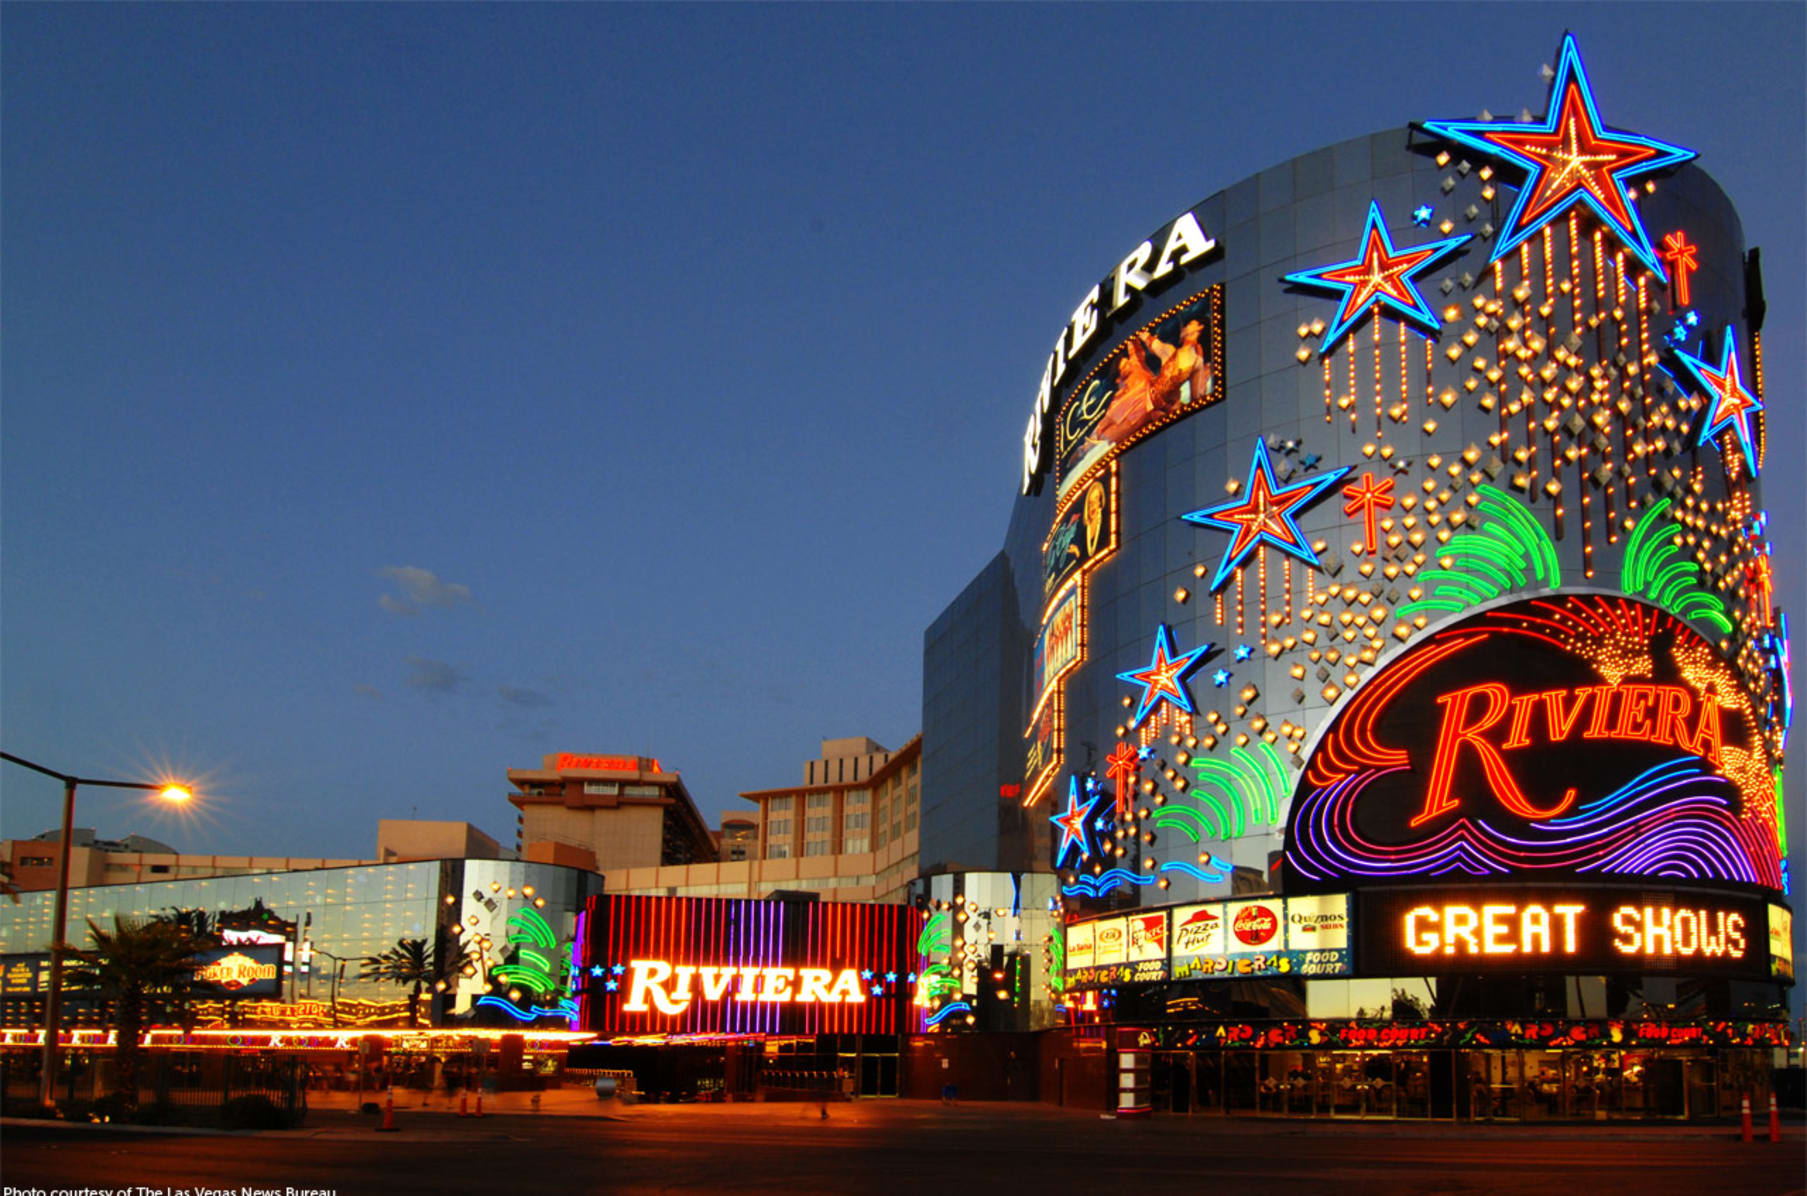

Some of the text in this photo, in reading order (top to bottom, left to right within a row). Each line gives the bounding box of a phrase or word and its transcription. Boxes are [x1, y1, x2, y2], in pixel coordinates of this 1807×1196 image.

[1022, 209, 1217, 497] RIVIERA
[1410, 681, 1726, 828] RIVIERA
[1177, 921, 1219, 945] Pizza
[1184, 933, 1211, 949] Hut
[1403, 904, 1746, 958] GREAT SHOWS
[1174, 955, 1235, 979] MARDI
[1301, 963, 1343, 975] COURT
[1306, 952, 1339, 963] FOOD
[623, 959, 866, 1016] RIVIERA
[1339, 1027, 1376, 1041] FOOD
